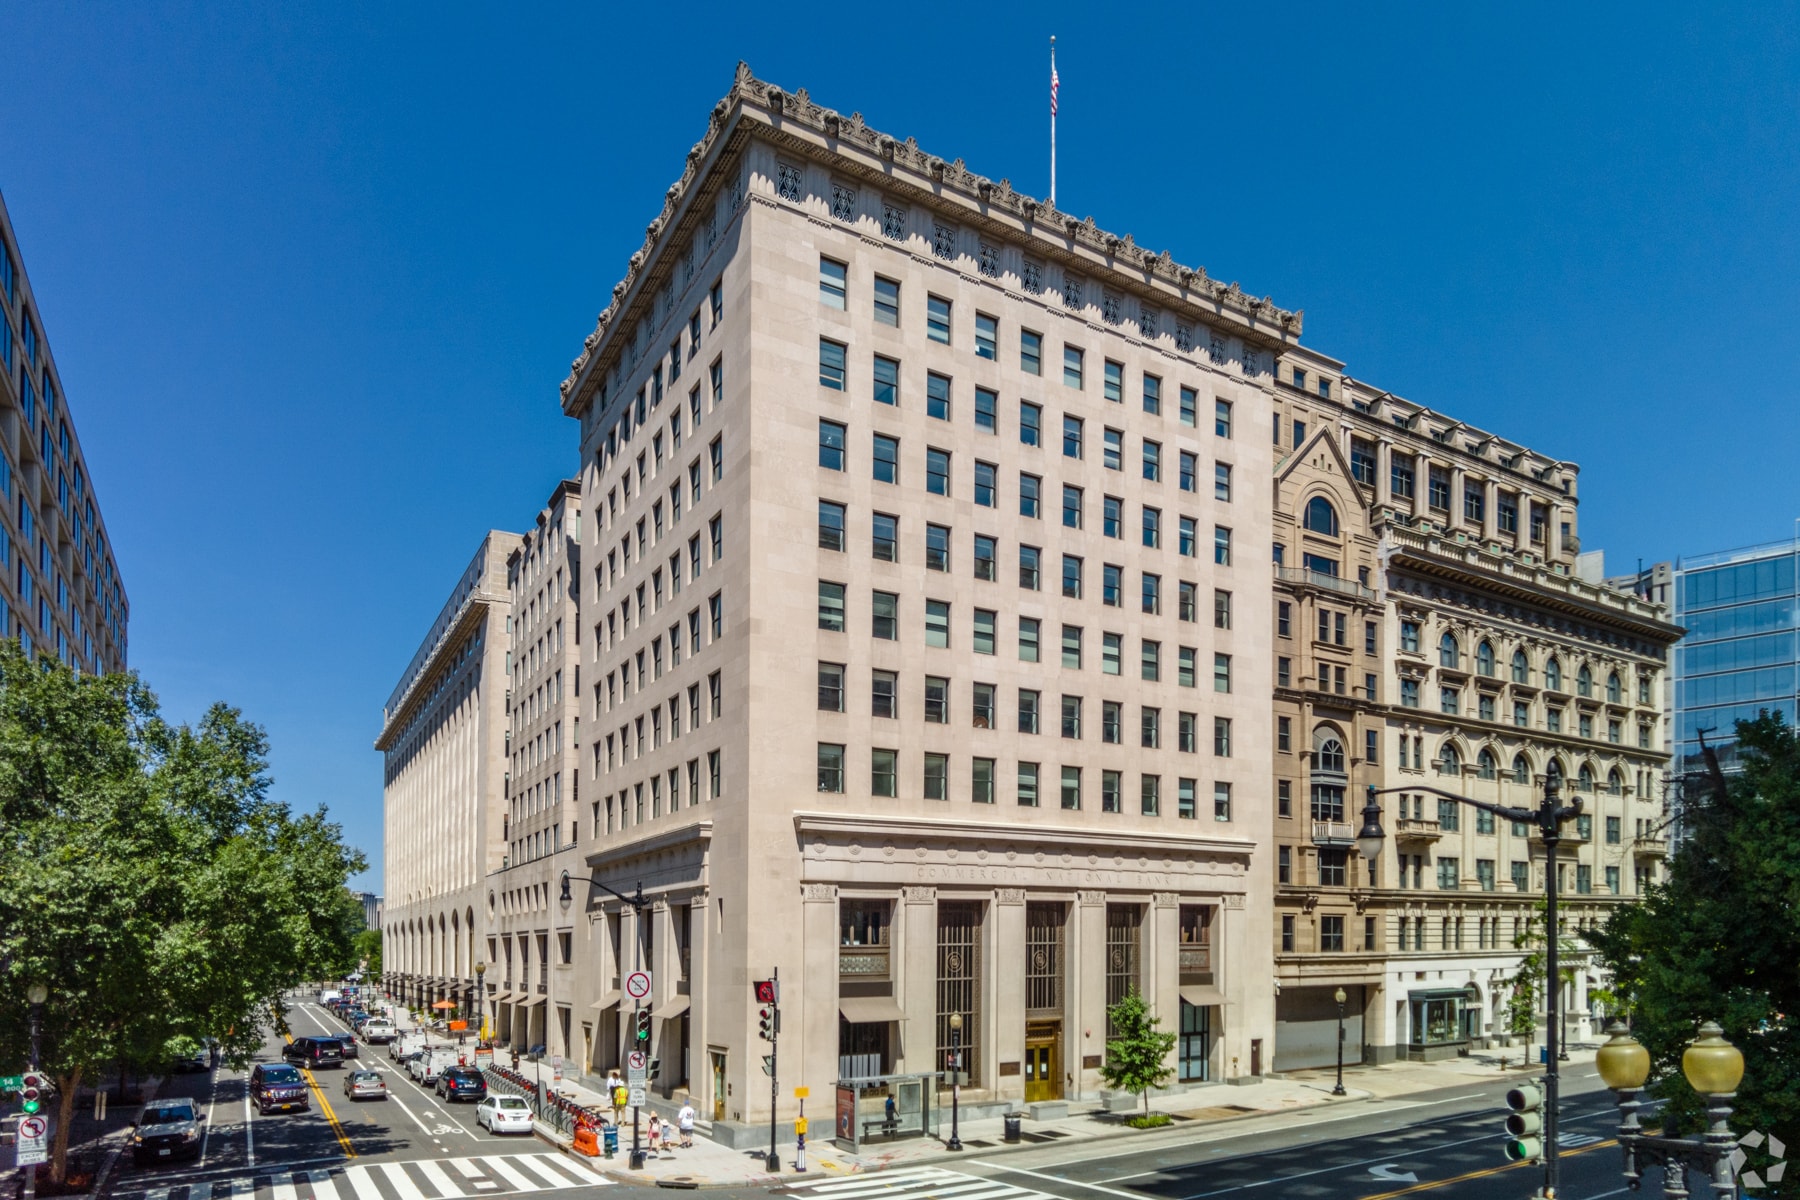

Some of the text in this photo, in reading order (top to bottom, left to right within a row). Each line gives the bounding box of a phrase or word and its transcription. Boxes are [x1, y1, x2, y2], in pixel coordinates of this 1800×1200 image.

[917, 867, 1170, 885] COMMERCIAL NATIONAL BANK
